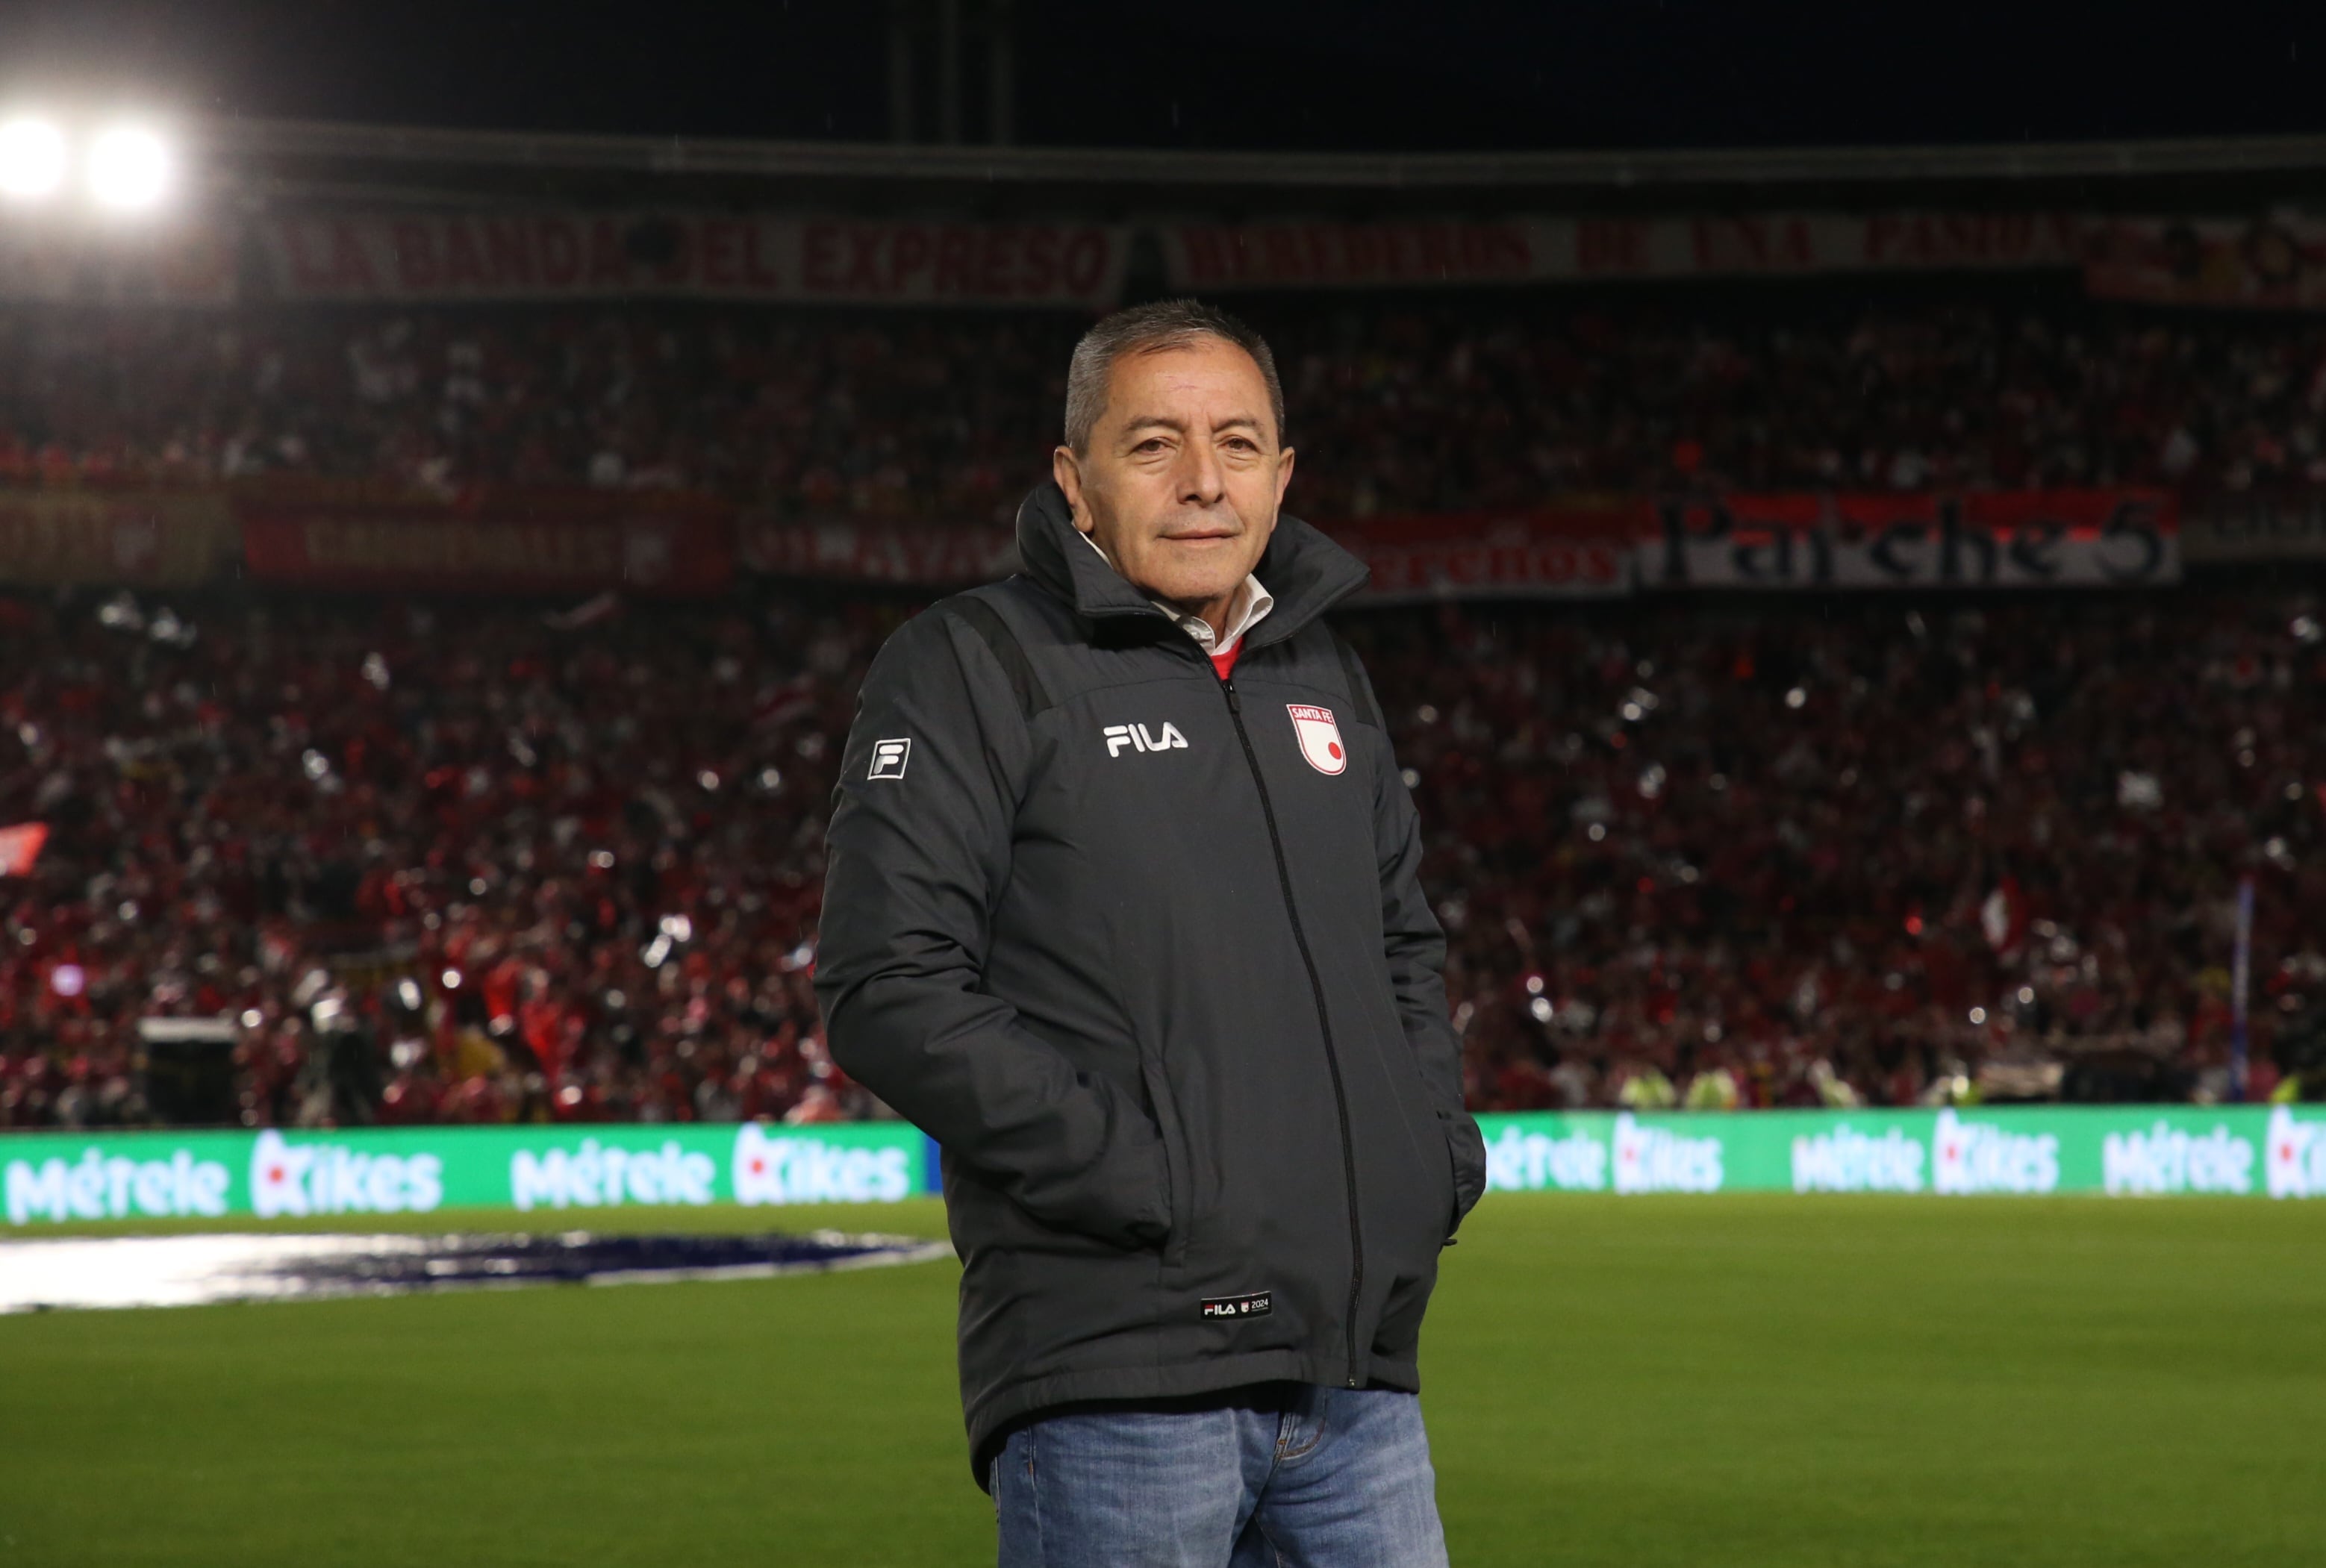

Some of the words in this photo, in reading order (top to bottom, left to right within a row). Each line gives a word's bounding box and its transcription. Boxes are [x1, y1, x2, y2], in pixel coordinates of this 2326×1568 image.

[283, 221, 375, 287] LA
[393, 219, 632, 287] BANDA
[802, 225, 1111, 296] EXPRESO
[1576, 217, 1651, 271] DE
[1690, 216, 1814, 269] UNA
[1657, 500, 2066, 582] Parche
[2096, 501, 2163, 584] 5
[1292, 708, 1321, 720] SANTA
[1321, 710, 1332, 723] FE
[873, 744, 904, 774] F
[1103, 721, 1188, 758] FILA
[1485, 1125, 1606, 1192] étele
[1204, 1303, 1236, 1315] FILA
[1251, 1299, 1268, 1308] 2024
